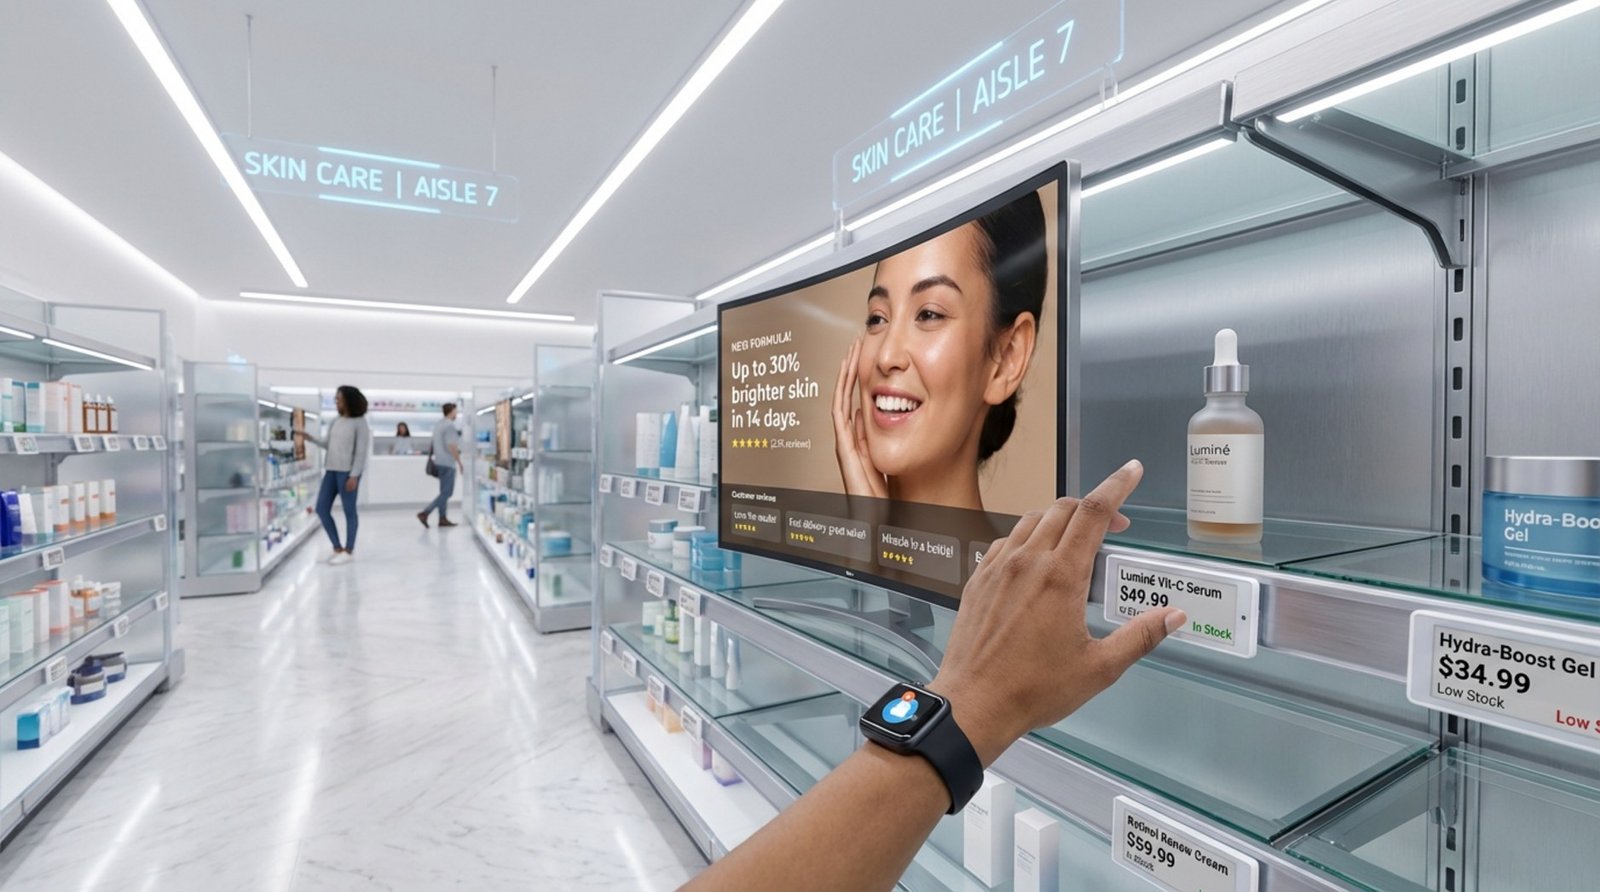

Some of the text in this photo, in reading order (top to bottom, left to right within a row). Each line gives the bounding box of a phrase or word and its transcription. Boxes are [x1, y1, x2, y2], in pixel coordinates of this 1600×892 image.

[852, 137, 889, 183] SKIN
[894, 101, 945, 158] CARE
[972, 38, 1045, 114] AISLE
[1056, 19, 1075, 64] 7
[244, 151, 306, 182] SKIN
[316, 161, 383, 192] CARE
[414, 176, 478, 205] AISLE
[485, 186, 498, 207] 7
[750, 330, 792, 349] FORMULA!
[731, 352, 800, 384] Up to 30%
[731, 377, 818, 407] brighter skin
[731, 409, 743, 428] in
[746, 409, 761, 428] 14
[1190, 444, 1230, 456] Luminé
[1504, 526, 1528, 542] Gel
[1120, 569, 1222, 599] Luminé Vit-C Serum
[1120, 585, 1169, 608] $49.99
[1192, 621, 1232, 640] In Stock
[1440, 632, 1596, 678] Hydra-Boost Gel
[1438, 654, 1531, 694] $34.99
[1437, 682, 1505, 709] Low Stock
[1556, 709, 1590, 730] Low
